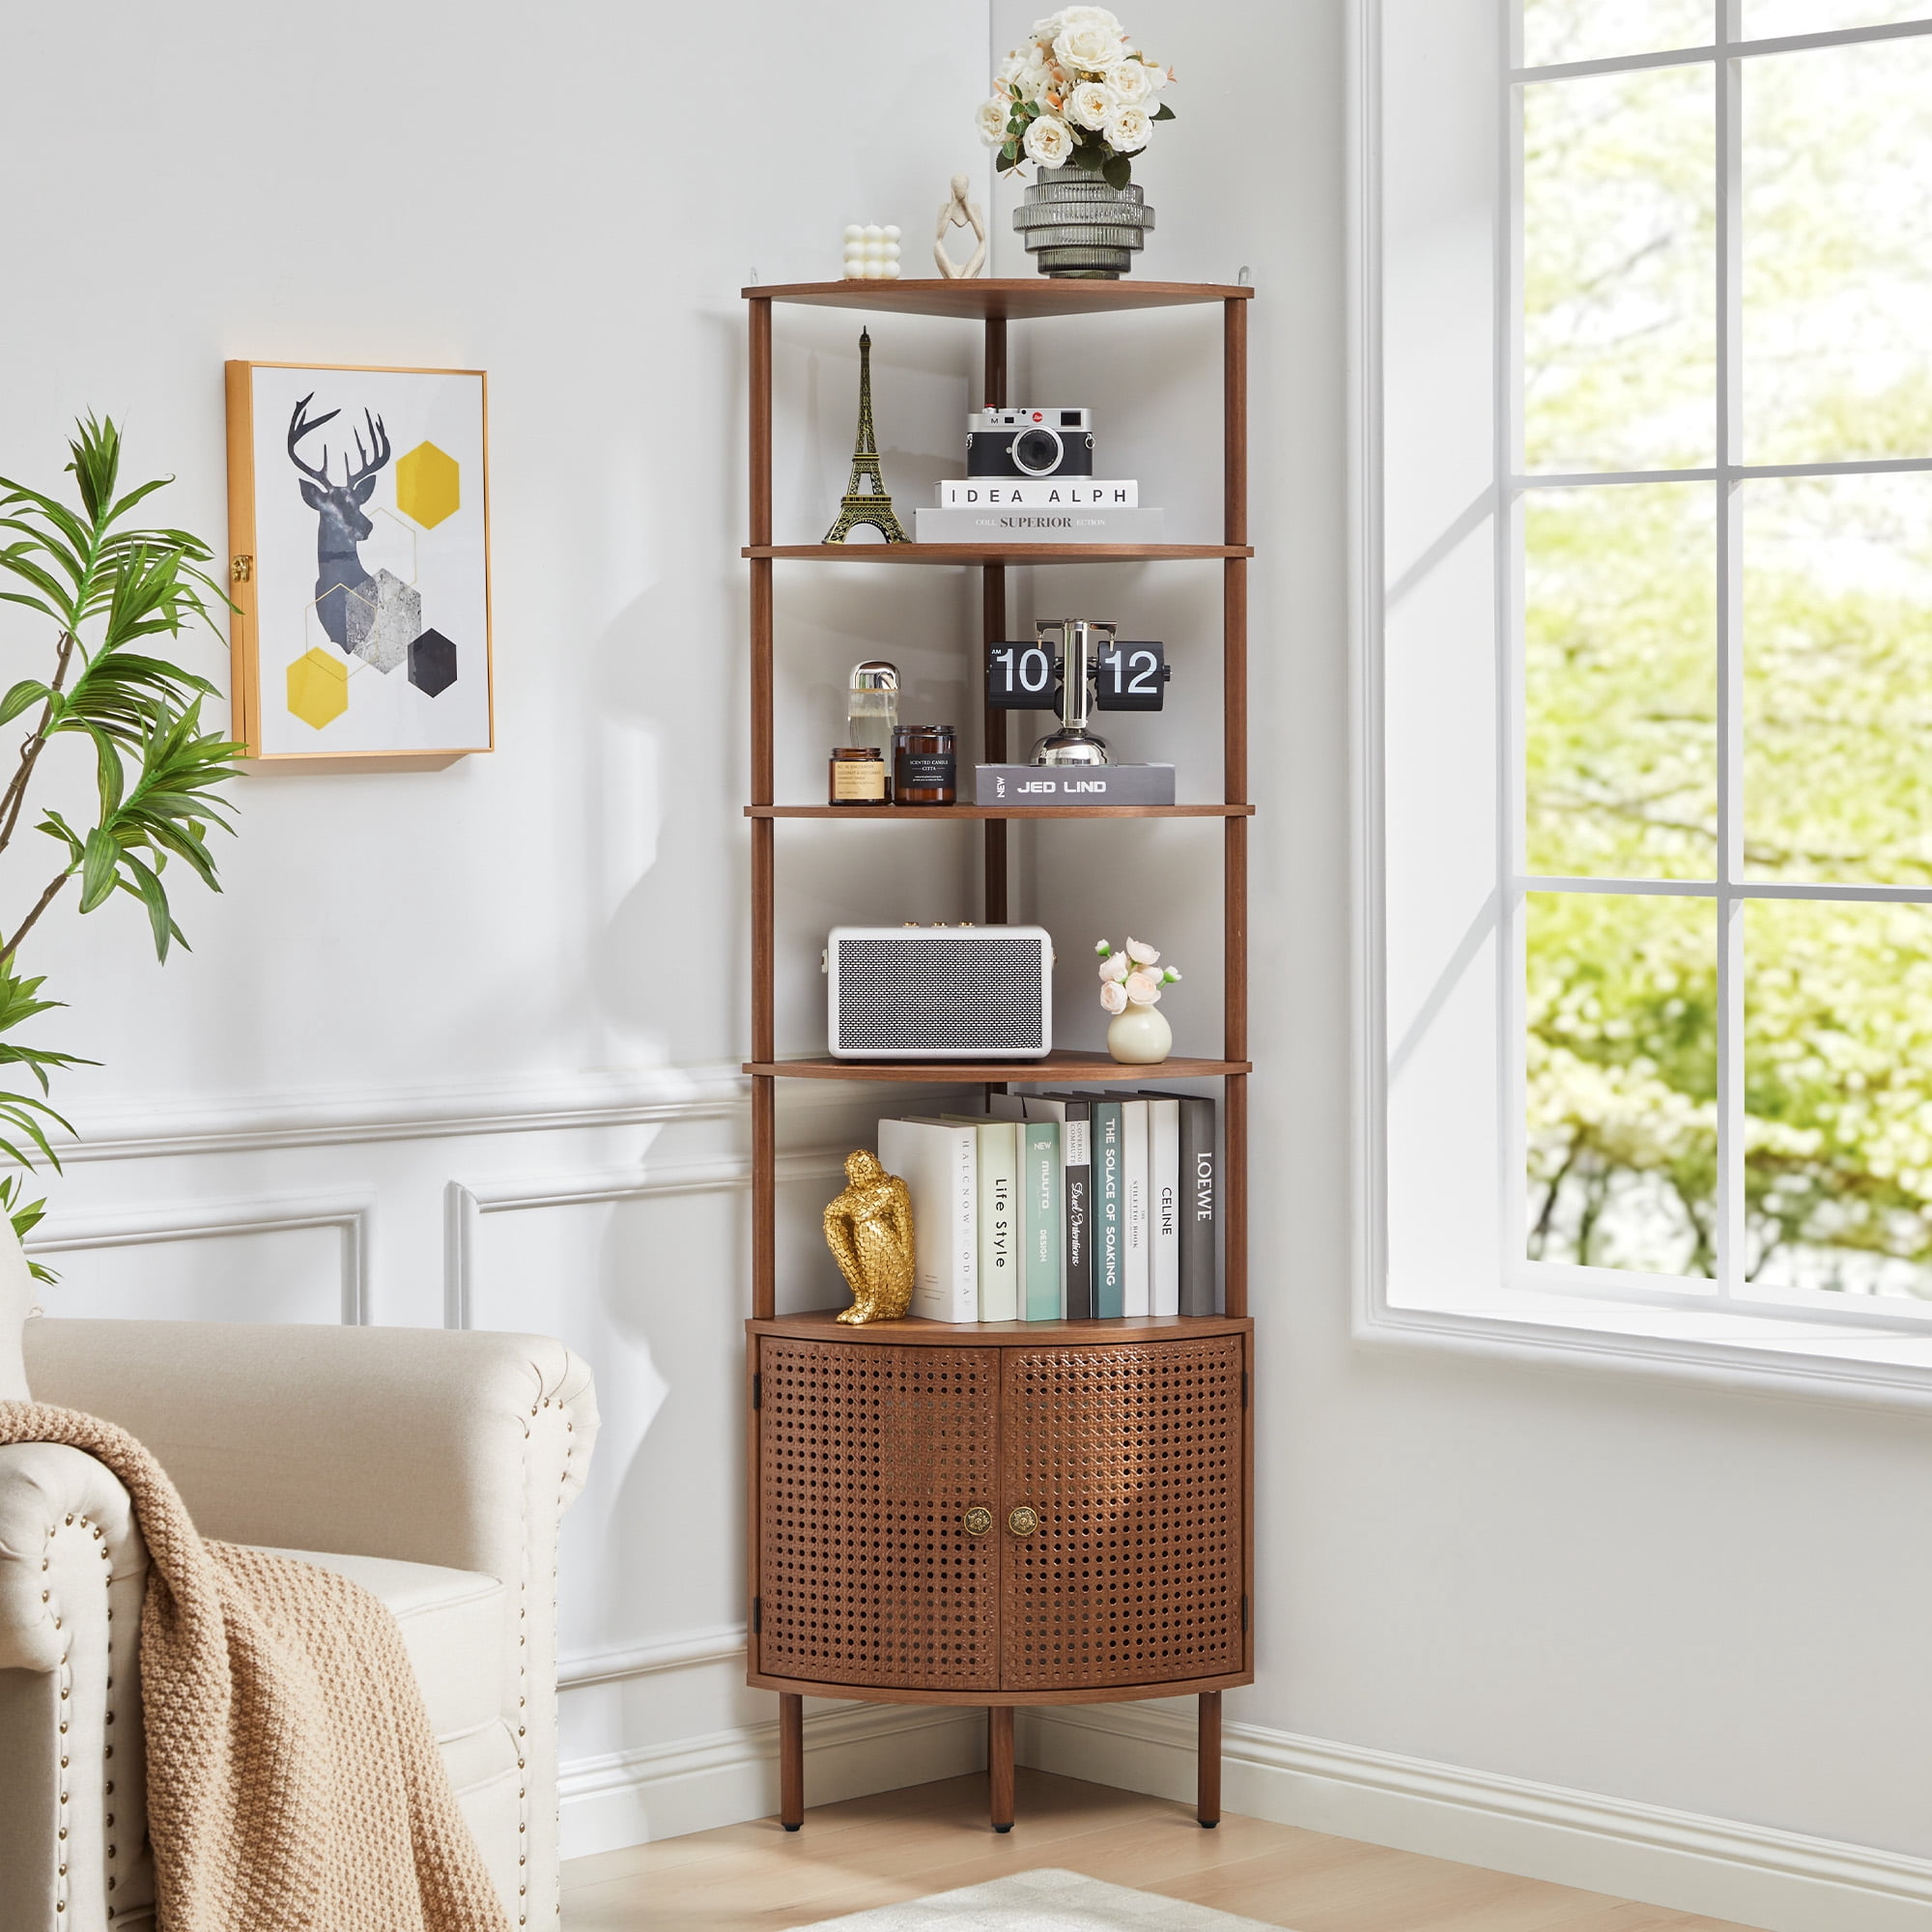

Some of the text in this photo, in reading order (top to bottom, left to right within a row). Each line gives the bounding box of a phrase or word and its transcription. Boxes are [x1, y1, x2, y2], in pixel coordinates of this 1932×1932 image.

[952, 490, 1126, 502] IDEA ALPH
[1000, 517, 1073, 528] SUPERIOR
[996, 648, 1158, 694] 10 12
[997, 777, 1006, 798] NEW
[1016, 781, 1107, 793] JED LIND
[1034, 1142, 1052, 1151] NEW
[1105, 1118, 1116, 1287] THE SOLACE OF SOAKING
[1197, 1151, 1212, 1222] LOEWE
[993, 1179, 1008, 1267] Life Style
[1161, 1186, 1173, 1236] CELINE
[1039, 1229, 1048, 1263] DESIGN
